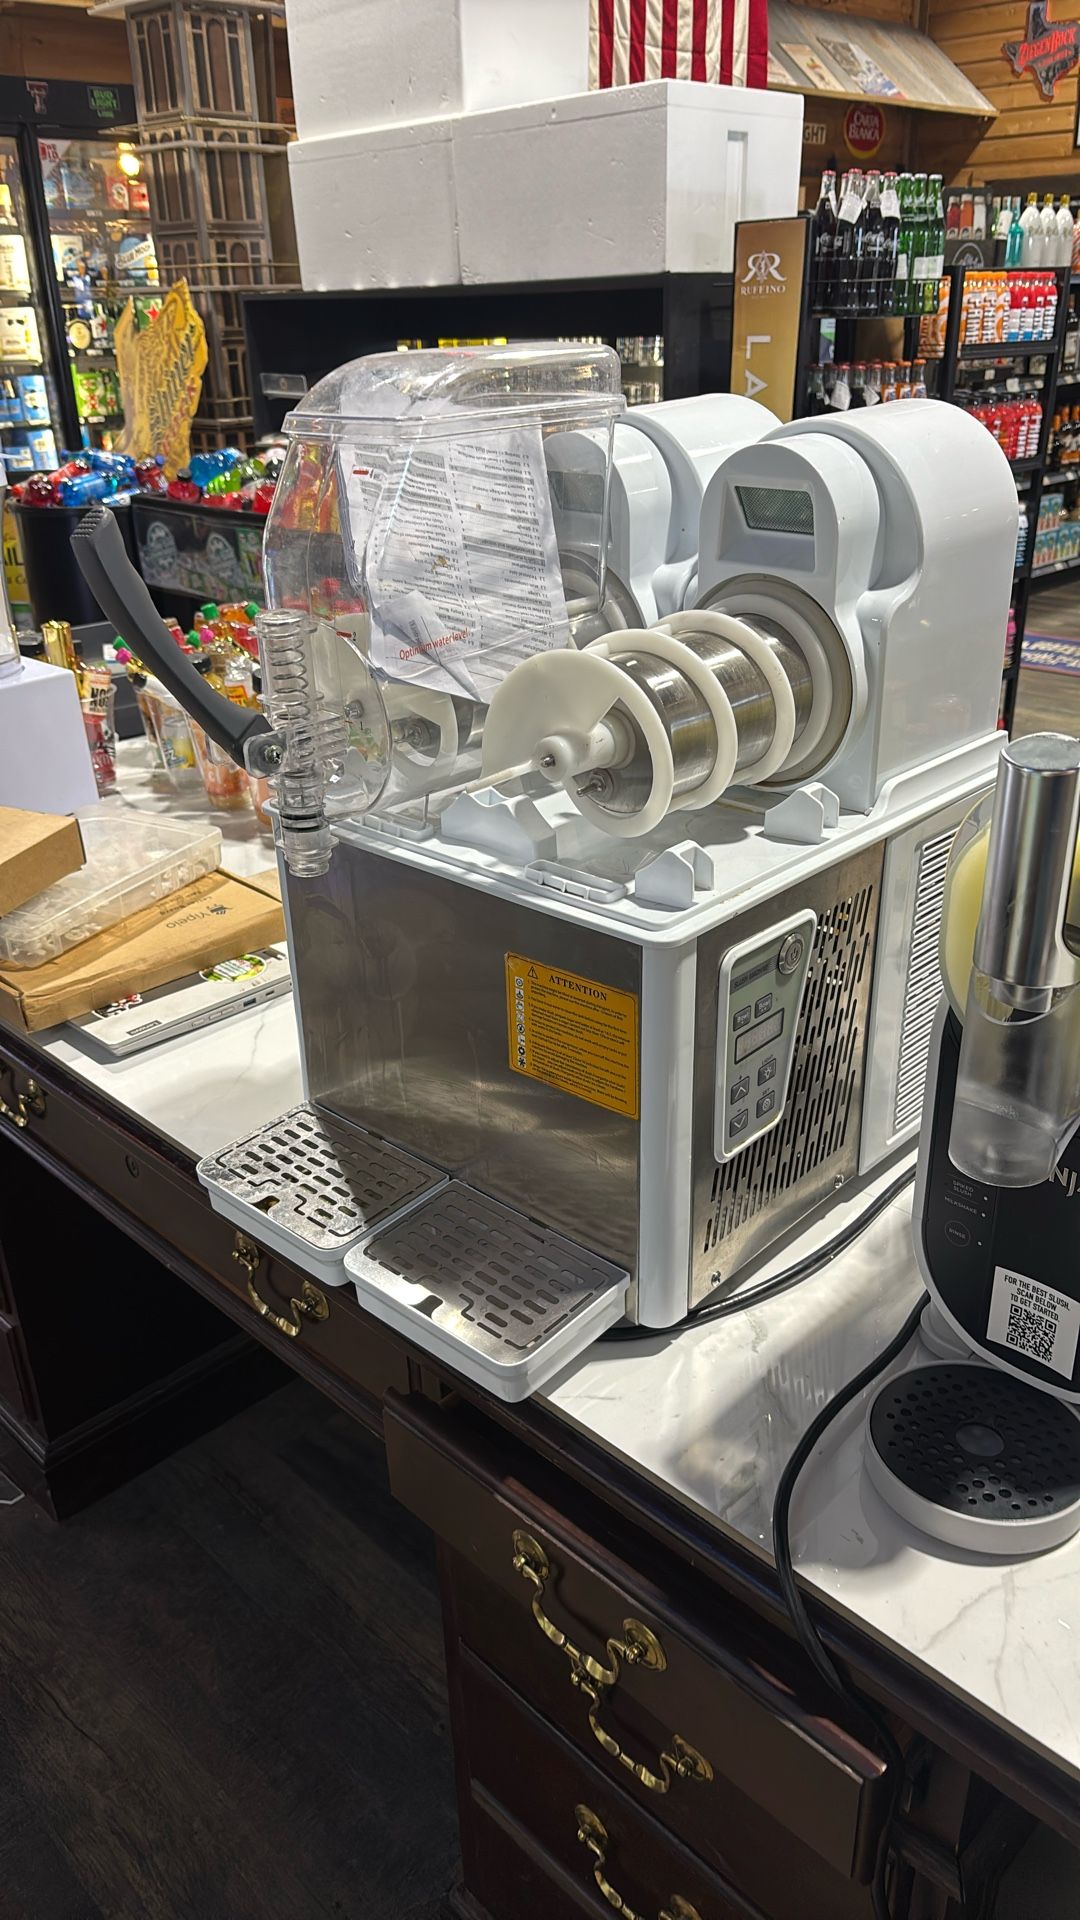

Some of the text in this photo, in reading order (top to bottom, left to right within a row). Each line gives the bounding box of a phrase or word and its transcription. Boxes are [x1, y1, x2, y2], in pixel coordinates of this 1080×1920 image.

[740, 285, 786, 296] RUFFINO
[352, 631, 357, 641] 2
[432, 635, 451, 648] water
[166, 908, 211, 930] Yipelo
[549, 975, 607, 1001] ATTENTION
[953, 1180, 974, 1193] SPIKED
[953, 1186, 973, 1198] SLUSH
[944, 1196, 978, 1215] MILKSHAKE
[949, 1227, 966, 1240] RINSE
[1004, 1275, 1018, 1286] FOR
[1018, 1280, 1031, 1291] THE
[1031, 1285, 1049, 1299] BEST
[1011, 1293, 1060, 1322] TO GET STARTED.
[1016, 1288, 1058, 1311] SCAN BELOW
